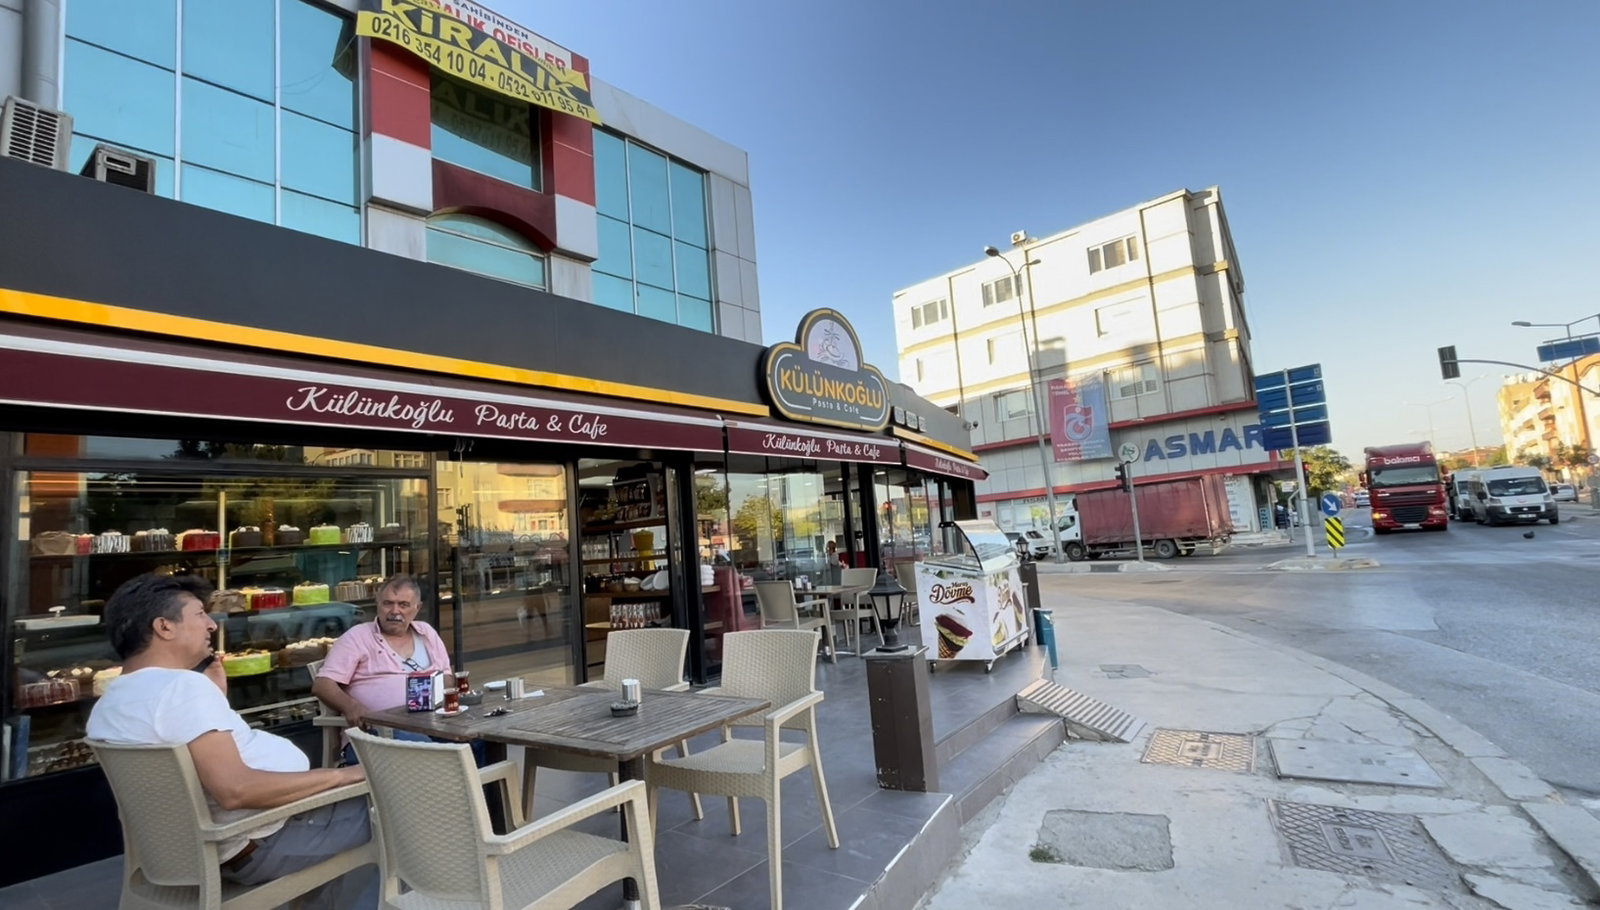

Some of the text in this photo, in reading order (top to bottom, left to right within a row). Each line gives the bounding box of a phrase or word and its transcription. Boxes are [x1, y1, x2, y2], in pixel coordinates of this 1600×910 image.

[371, 16, 411, 46] 0216
[415, 37, 441, 65] 354
[447, 50, 464, 73] 10
[469, 58, 486, 82] 04
[498, 71, 530, 98] 0532
[576, 103, 590, 119] 47
[381, 0, 589, 101] KİRALIK
[780, 365, 882, 409] KÜLÜNKOĞLU
[812, 397, 860, 415] Pasta & Cafe
[286, 386, 608, 440] Külünkoğlu Pasta & Cafe
[763, 434, 881, 460] Külünkoğlu Pasta & Cafe
